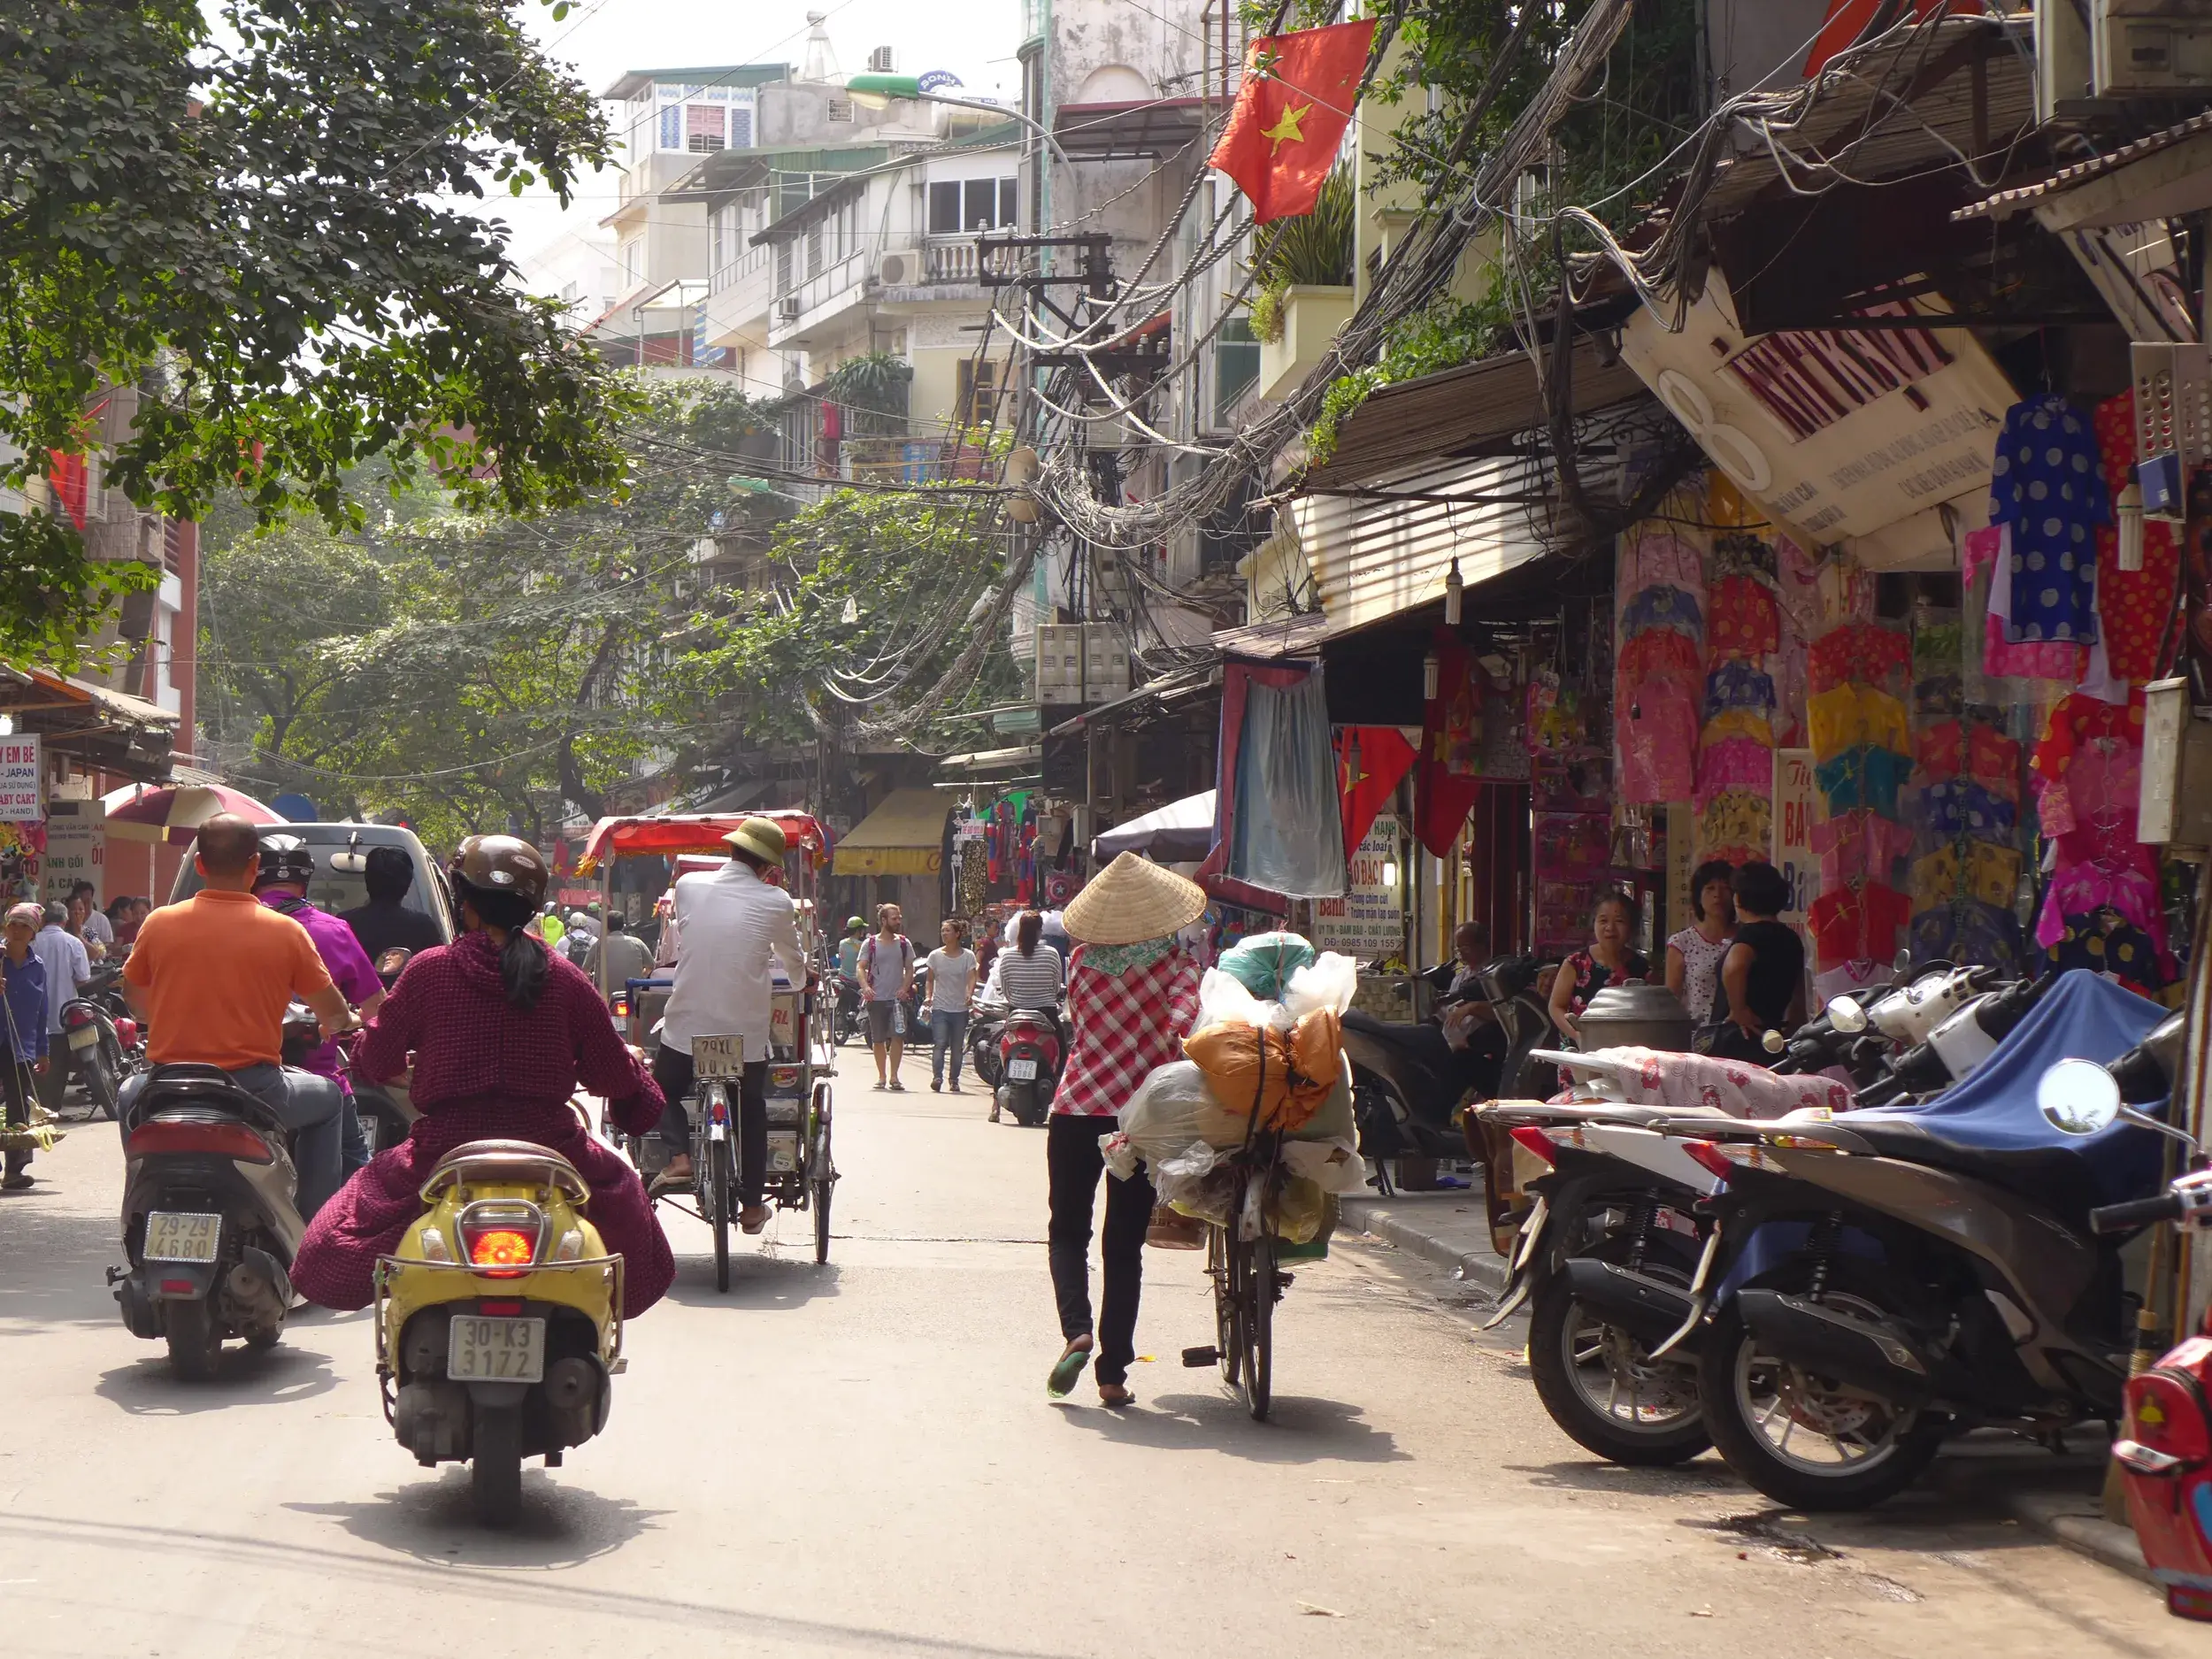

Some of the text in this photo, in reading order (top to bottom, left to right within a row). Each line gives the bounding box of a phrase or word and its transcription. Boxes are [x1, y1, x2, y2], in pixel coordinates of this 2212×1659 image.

[7, 746, 19, 764] EM
[6, 768, 34, 777] JAPAN
[16, 794, 35, 804] CART
[1341, 938, 1361, 947] 0985
[1363, 939, 1378, 948] 109
[158, 1216, 211, 1237] 29-Z9
[156, 1238, 207, 1258] 4680
[465, 1321, 531, 1348] 30-K3
[463, 1349, 533, 1377] 3172
